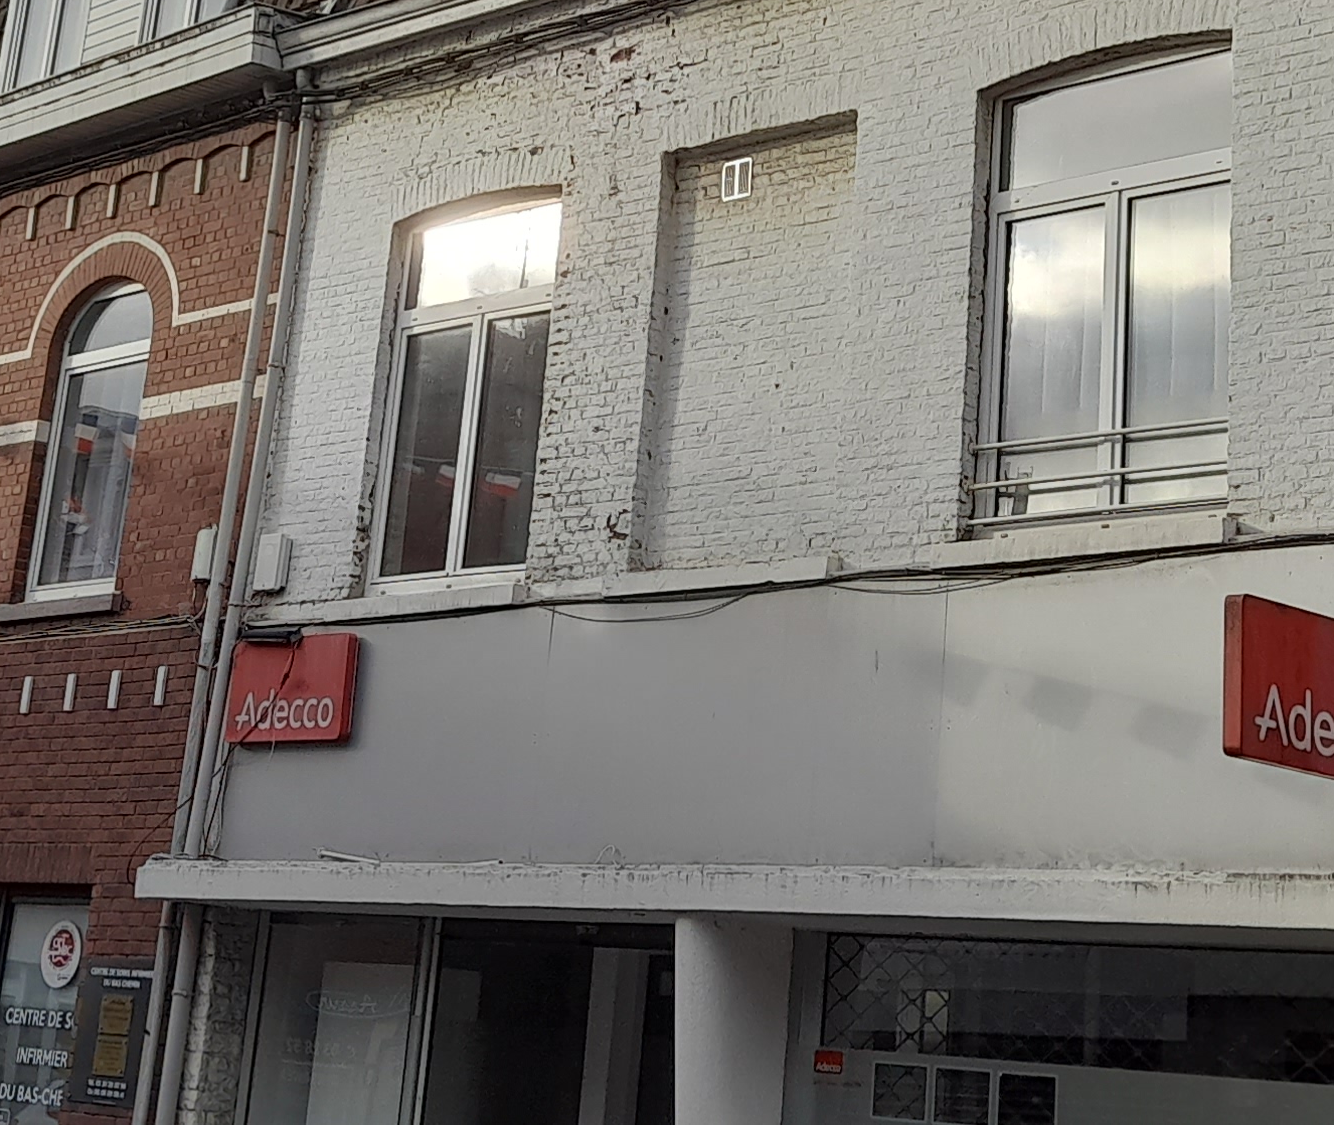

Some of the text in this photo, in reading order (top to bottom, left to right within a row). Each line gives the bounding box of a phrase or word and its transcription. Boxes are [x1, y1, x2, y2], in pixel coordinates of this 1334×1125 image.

[235, 688, 334, 732] Adecco
[5, 1006, 46, 1026] CENTRE
[47, 1011, 63, 1028] DE
[16, 1047, 68, 1068] INFIRMIER
